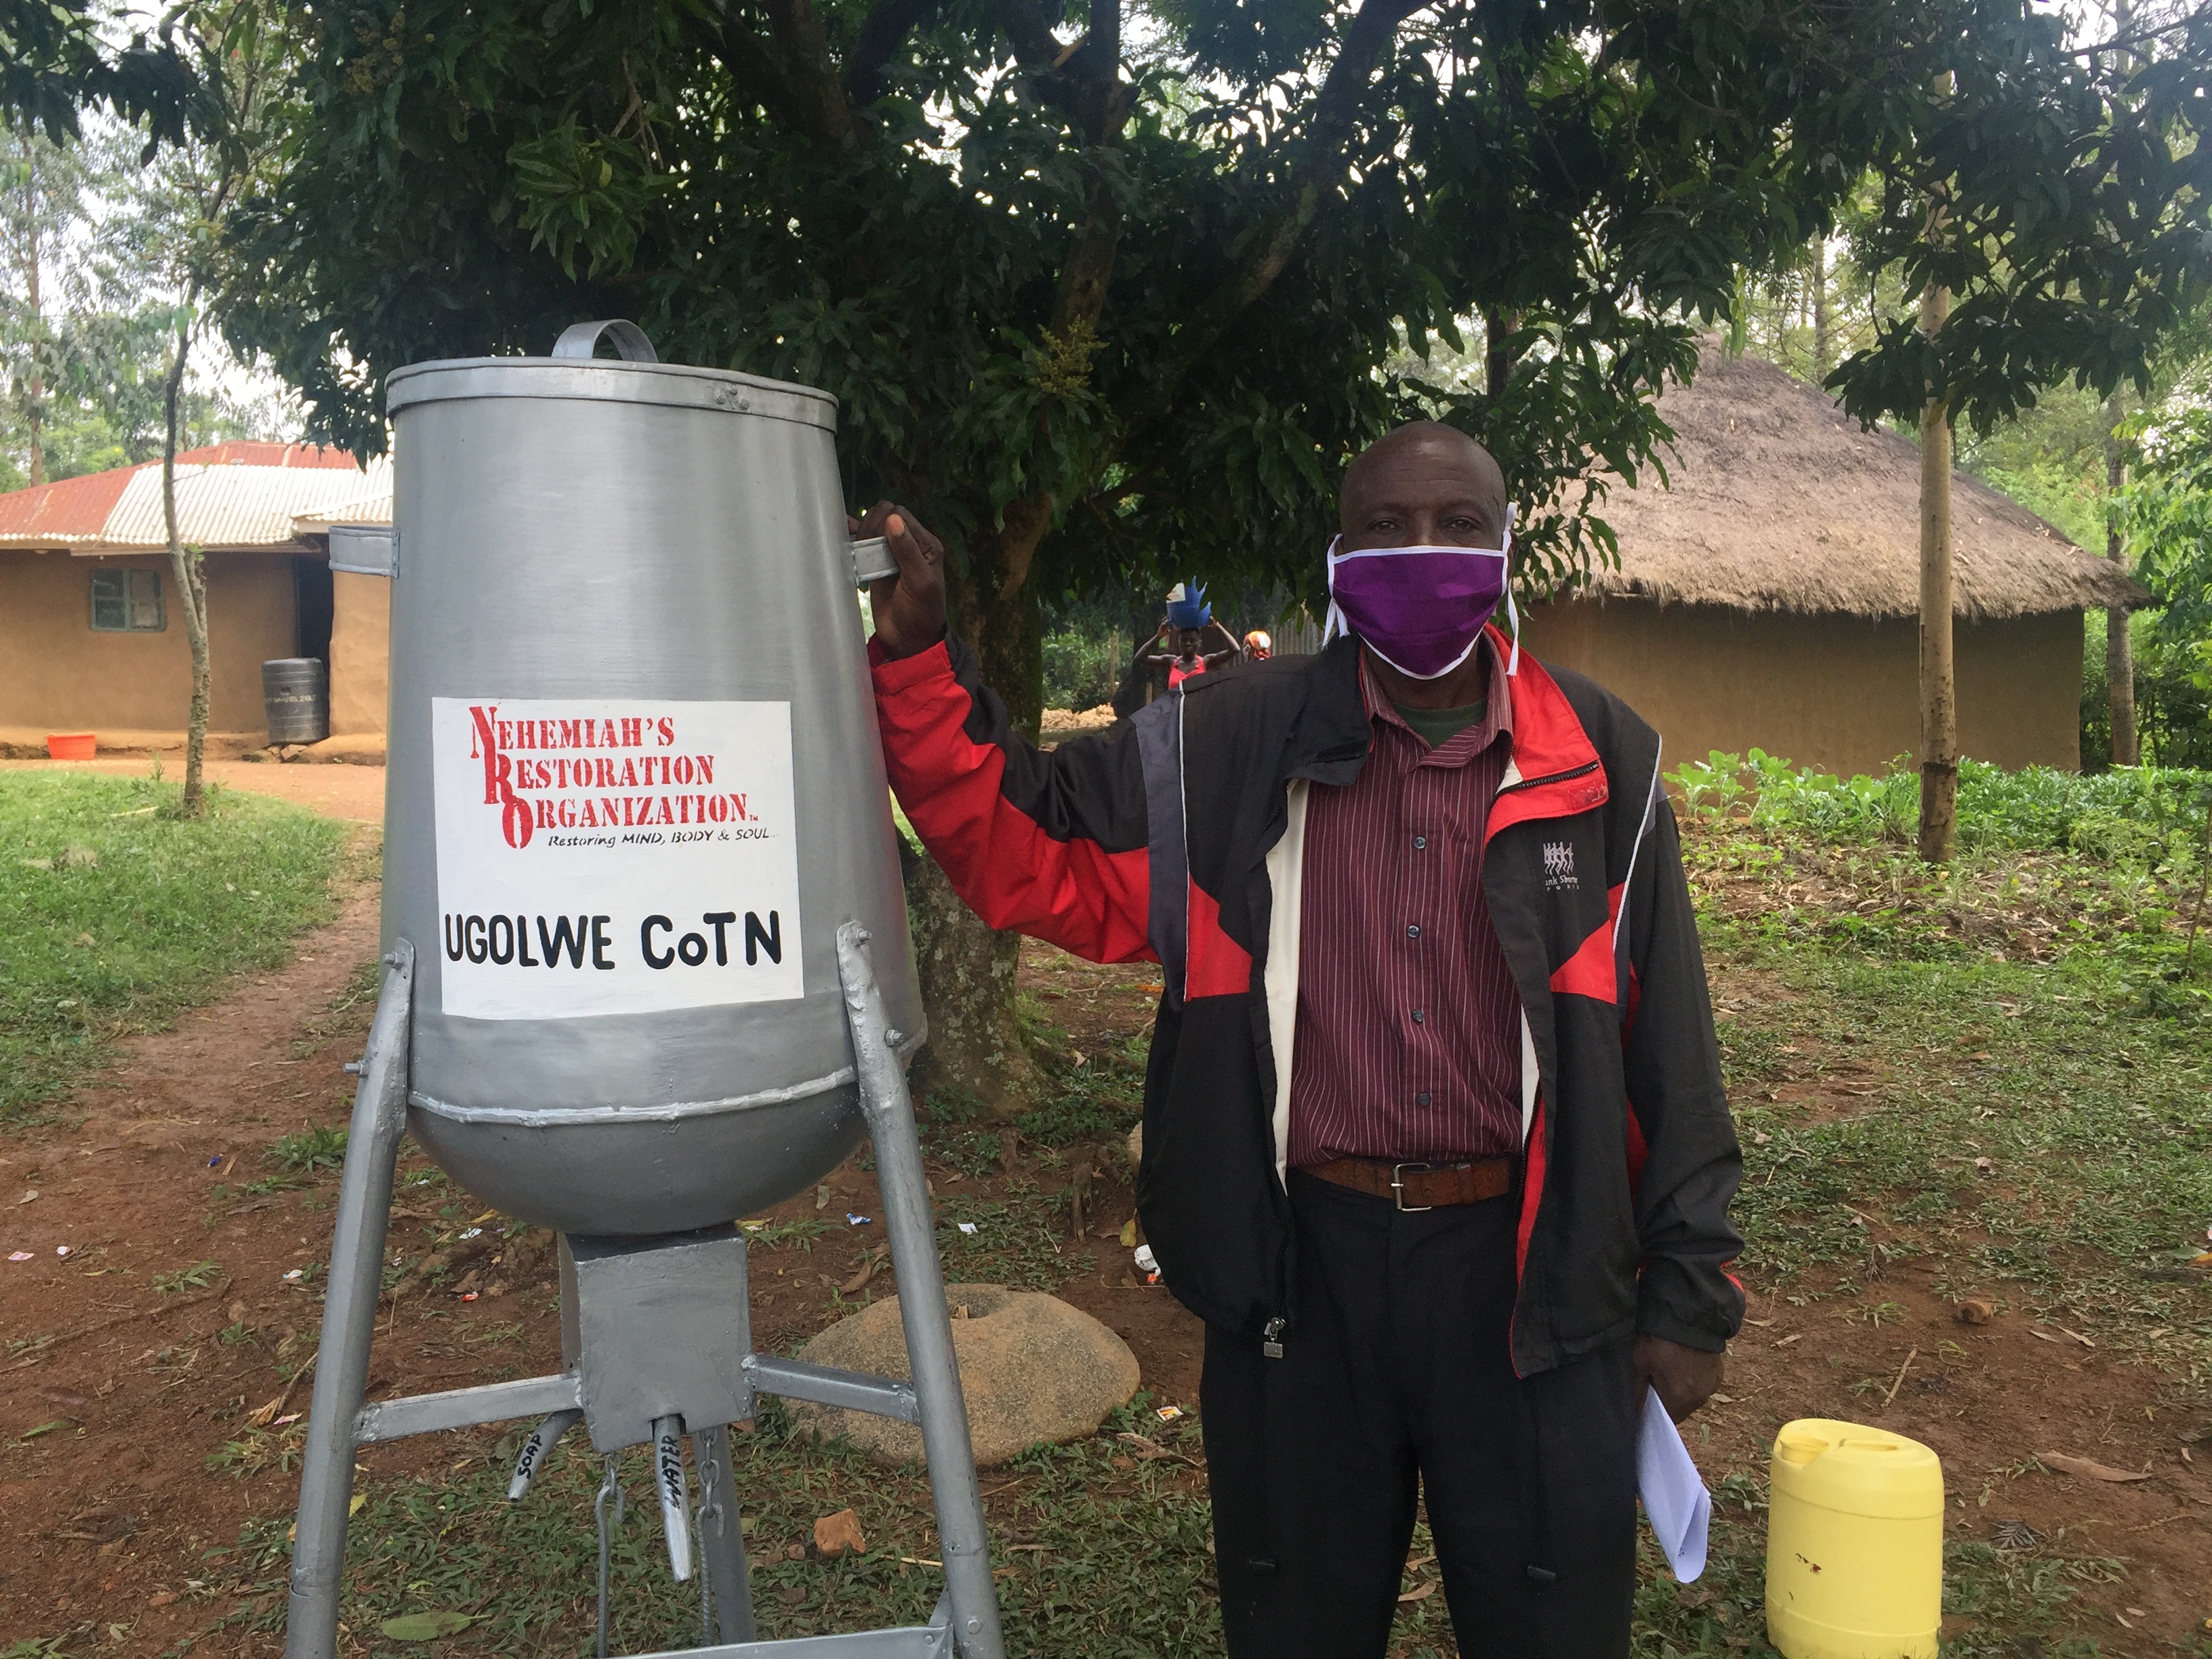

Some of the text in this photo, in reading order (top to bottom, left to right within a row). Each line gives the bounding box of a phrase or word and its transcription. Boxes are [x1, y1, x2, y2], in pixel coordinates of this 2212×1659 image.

[469, 706, 674, 758] NEHEMIAH'S
[483, 754, 714, 804] RESTORATION
[501, 793, 747, 849] ORGANIZATION
[548, 833, 616, 848] Restoring
[621, 832, 665, 846] MIND,
[671, 829, 714, 844] BODY
[718, 829, 731, 842] &
[445, 914, 615, 970] UGOLWE
[517, 1434, 543, 1479] SOAP
[660, 1435, 682, 1509] WATER
